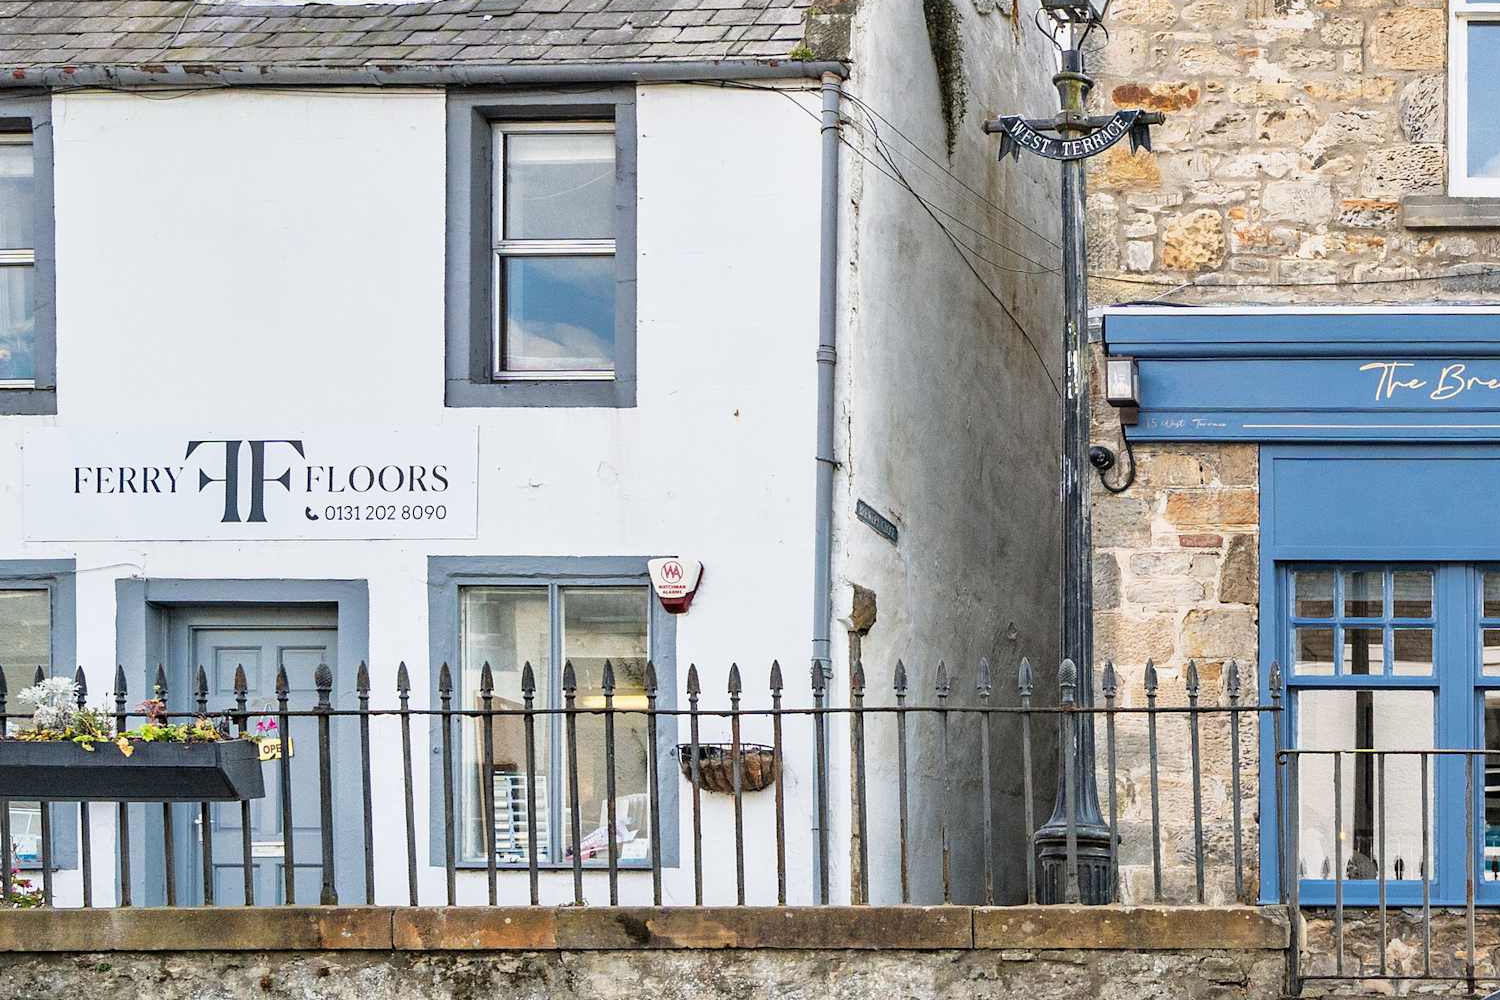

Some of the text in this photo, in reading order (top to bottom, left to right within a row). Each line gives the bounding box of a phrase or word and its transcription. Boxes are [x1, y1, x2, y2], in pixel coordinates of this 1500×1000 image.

[1010, 115, 1128, 156] WEST TERRACE
[1360, 361, 1427, 401] The
[74, 466, 184, 493] FERRY
[306, 465, 449, 492] FLOORS
[325, 505, 447, 521] 0131 202 8090
[263, 743, 286, 754] OPE
